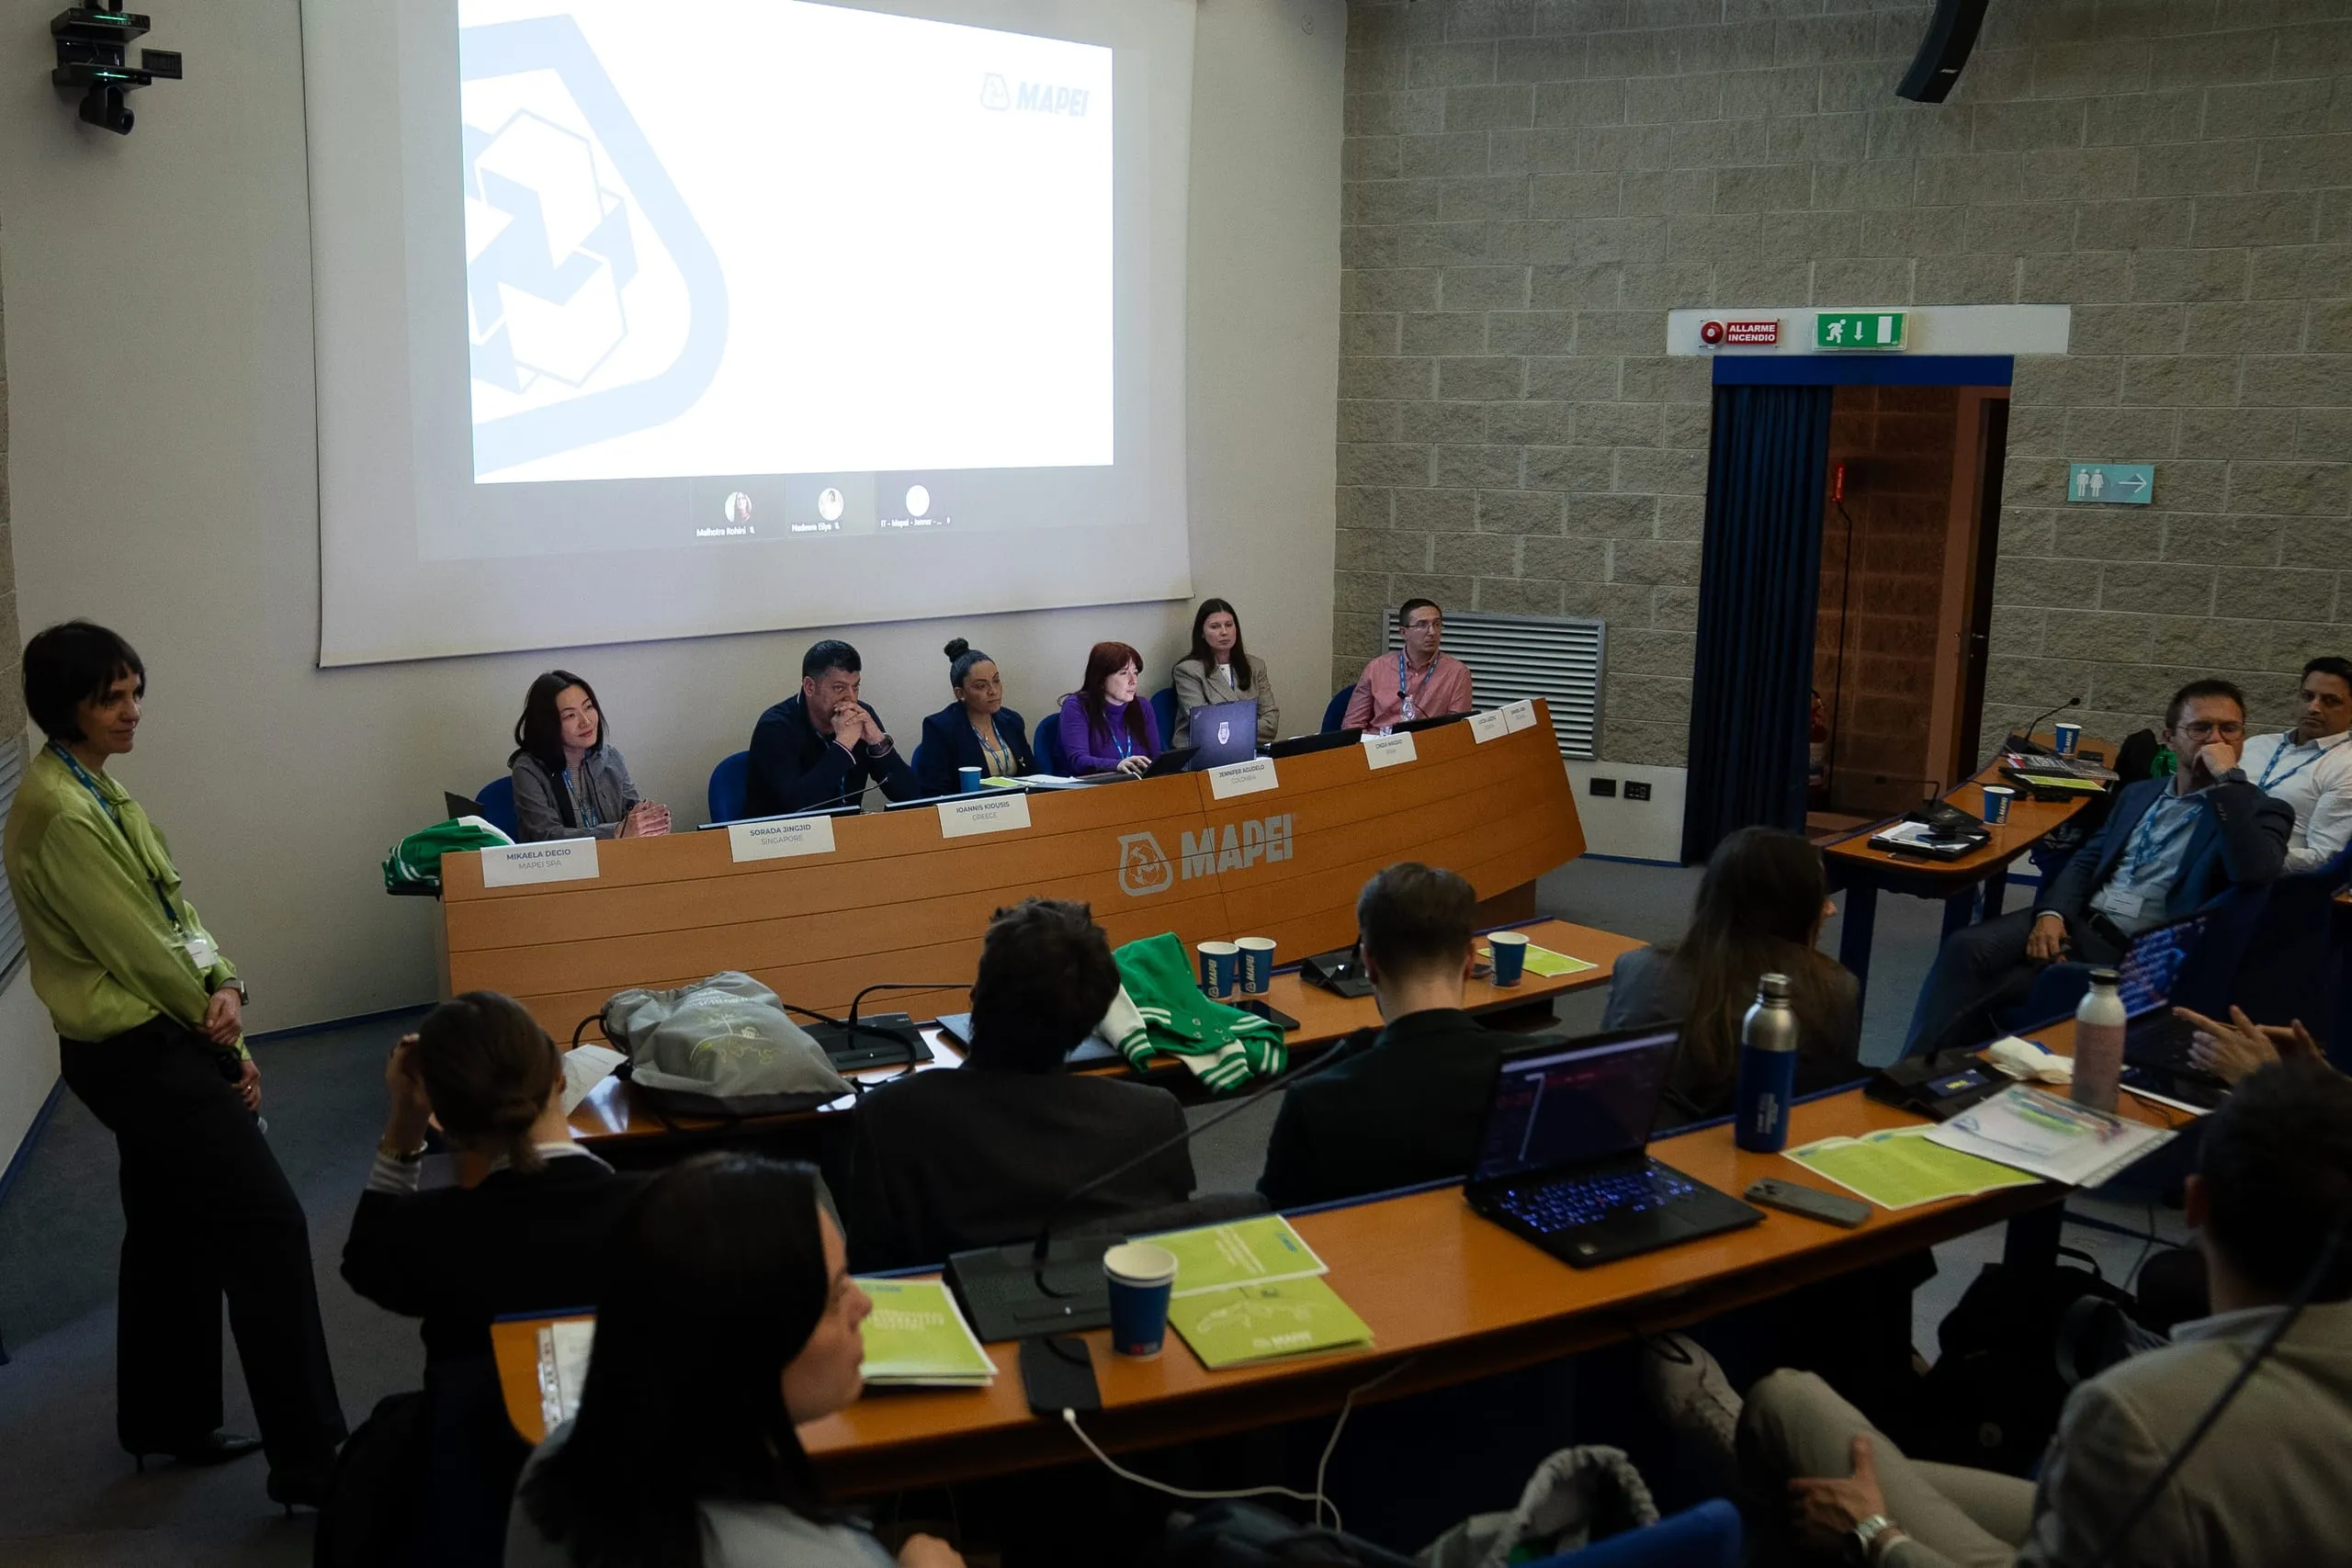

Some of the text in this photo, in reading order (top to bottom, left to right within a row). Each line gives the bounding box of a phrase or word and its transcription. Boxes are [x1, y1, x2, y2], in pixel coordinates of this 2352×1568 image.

[1016, 81, 1091, 117] MAPEI
[1729, 324, 1776, 333] ALLARME
[1728, 333, 1776, 342] INCENDIO
[1218, 768, 1242, 778] JENNIFER
[956, 801, 1011, 813] IOANNIS KIOUSIS
[750, 824, 811, 837] SORADA JINGJID
[761, 835, 803, 845] SINGAPORE
[1182, 813, 1293, 880] MAPEI
[506, 848, 571, 861] MIKAELA DECIO
[518, 859, 562, 869] MAPEI SPA
[1208, 958, 1218, 987] MAPEI
[1245, 954, 1256, 982] MAPEI
